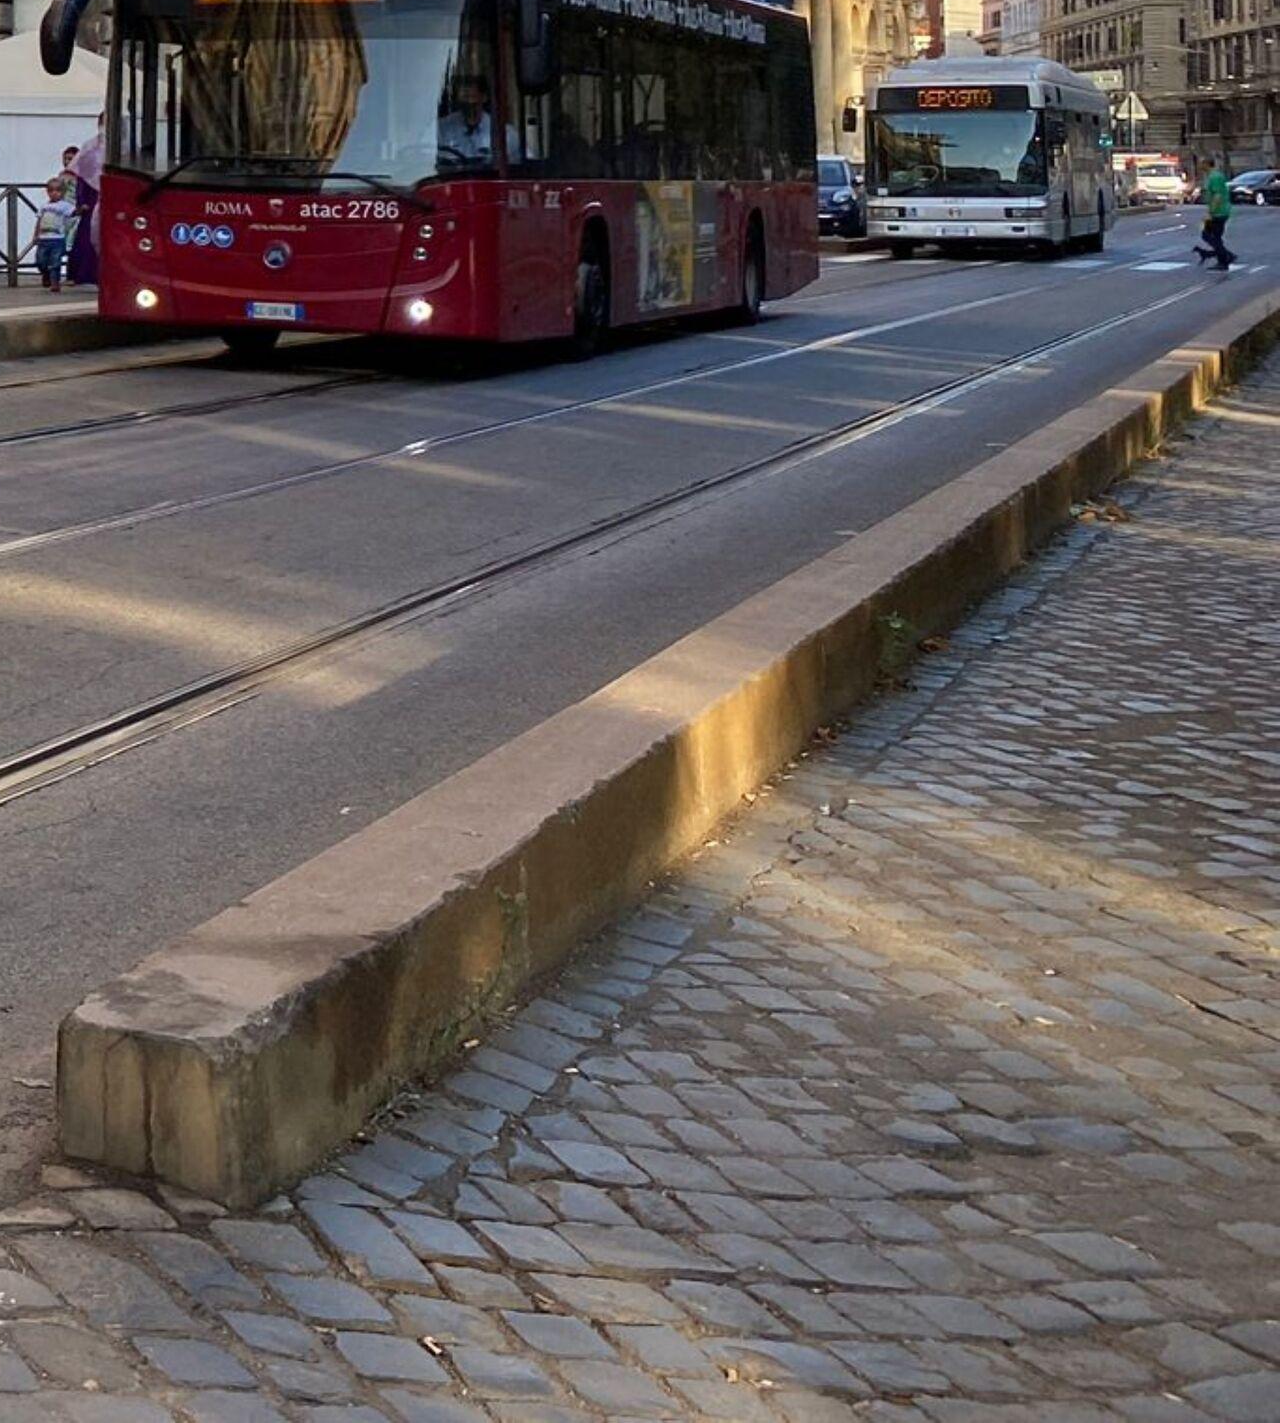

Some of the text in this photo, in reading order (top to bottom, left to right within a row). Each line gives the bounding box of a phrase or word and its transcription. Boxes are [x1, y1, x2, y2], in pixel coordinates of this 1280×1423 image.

[918, 89, 993, 108] DEPOSITO
[204, 200, 400, 219] ROMA atac 2786
